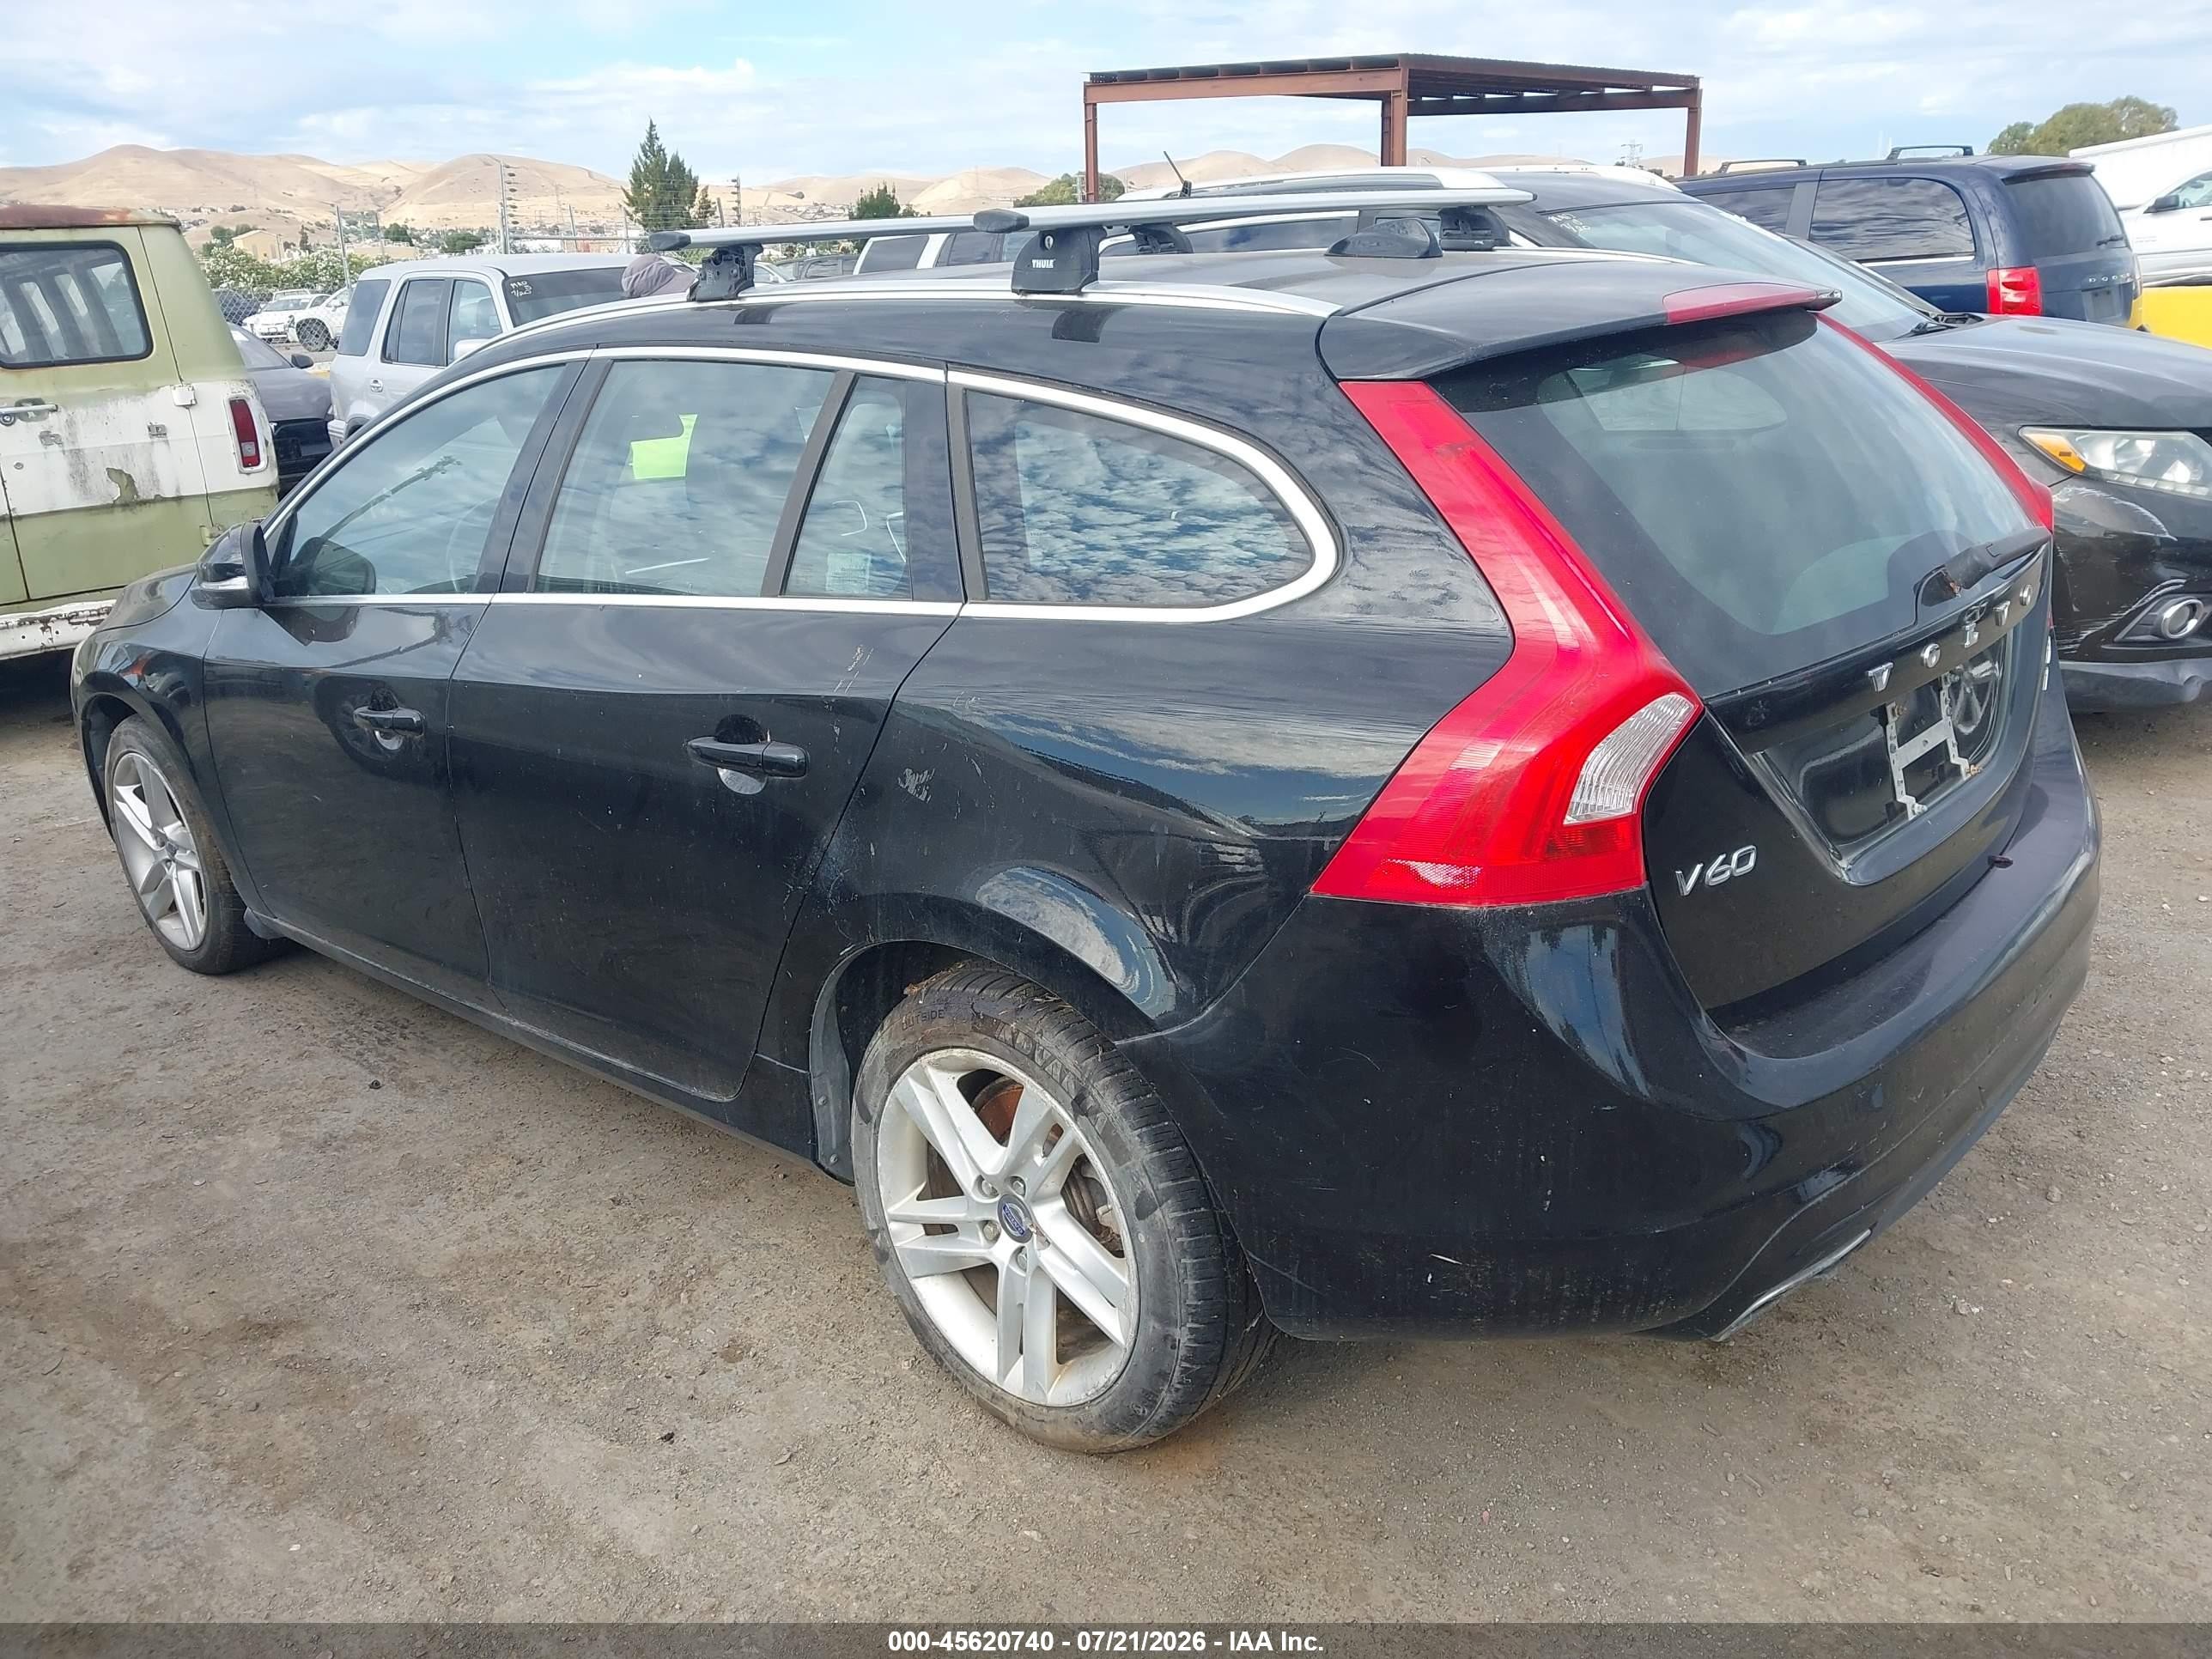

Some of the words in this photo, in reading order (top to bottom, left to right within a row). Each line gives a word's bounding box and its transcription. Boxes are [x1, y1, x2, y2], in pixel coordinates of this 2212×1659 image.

[1031, 258, 1054, 269] THULE
[2088, 272, 2130, 283] DOD
[1866, 584, 2033, 692] VOLVO
[1675, 845, 1757, 896] V60
[902, 1009, 945, 1031] OUTSIDE
[1005, 1206, 1024, 1235] VOLVO
